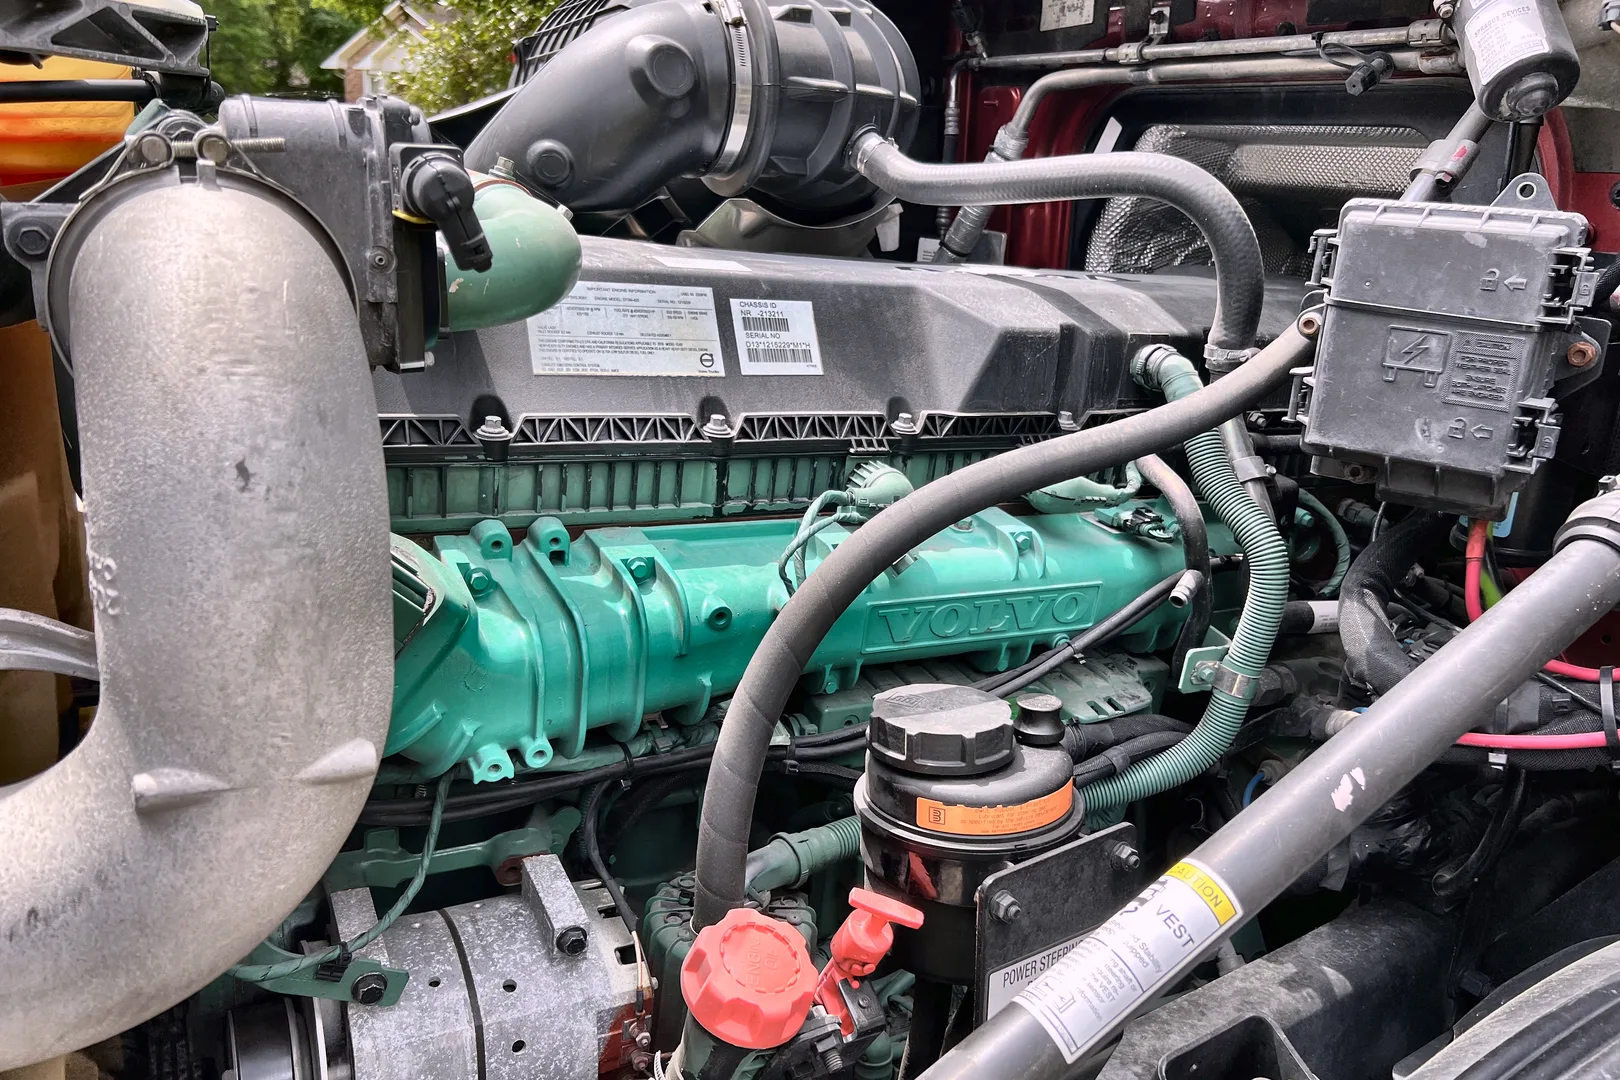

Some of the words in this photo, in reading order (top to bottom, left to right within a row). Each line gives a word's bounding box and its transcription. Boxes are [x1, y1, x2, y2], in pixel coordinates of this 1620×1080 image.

[1502, 5, 1531, 18] DEVICES
[740, 301, 769, 309] CHASSIS
[878, 592, 1087, 643] VOLVO
[1155, 904, 1194, 948] VEST
[764, 950, 778, 971] OIL
[1003, 960, 1037, 988] POWER
[1039, 939, 1084, 972] STEERI
[1139, 942, 1164, 974] Stability
[1076, 986, 1103, 1021] nformation
